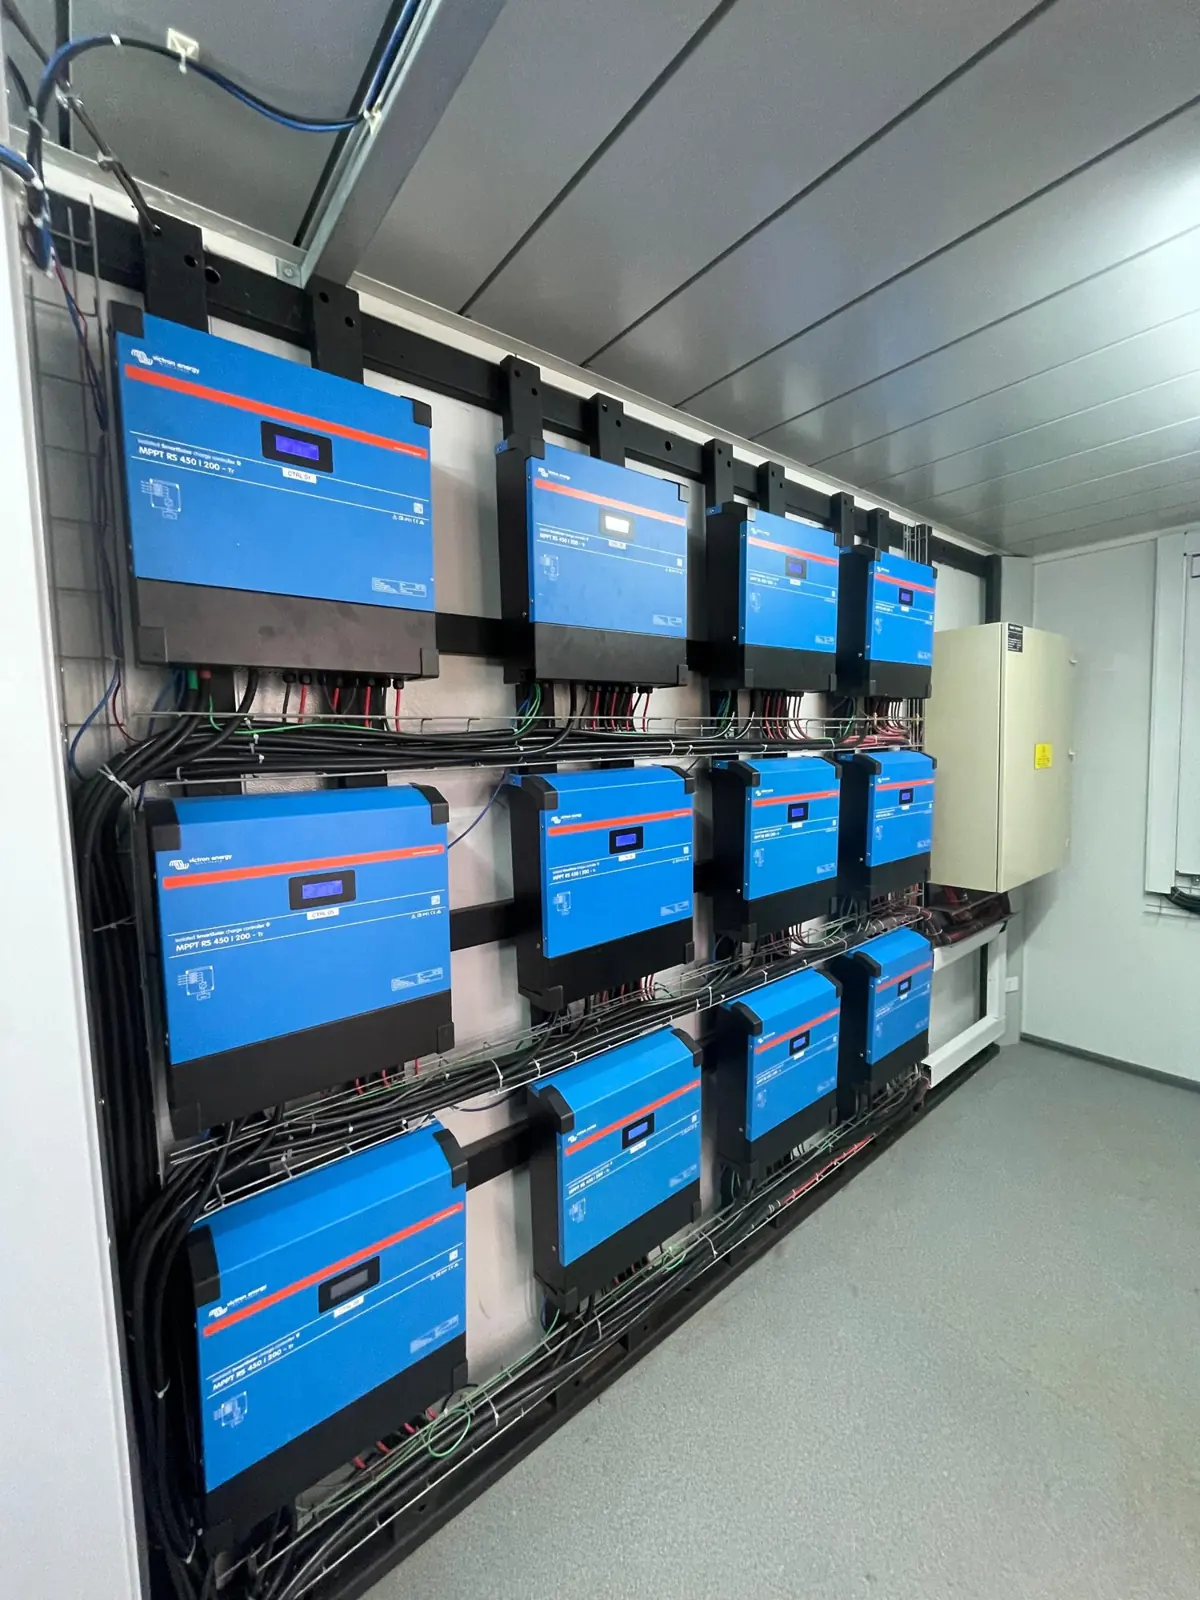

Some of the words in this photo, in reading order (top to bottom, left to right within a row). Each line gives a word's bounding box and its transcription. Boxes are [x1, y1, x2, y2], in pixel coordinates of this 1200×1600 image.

[152, 356, 176, 366] victron
[177, 363, 200, 374] energy
[138, 446, 164, 458] MPPT
[166, 452, 177, 461] RS
[180, 456, 196, 466] 450
[204, 461, 220, 471] 200
[176, 941, 199, 952] MPPT
[213, 936, 229, 945] 450
[235, 933, 250, 942] 200
[248, 1360, 262, 1371] 450
